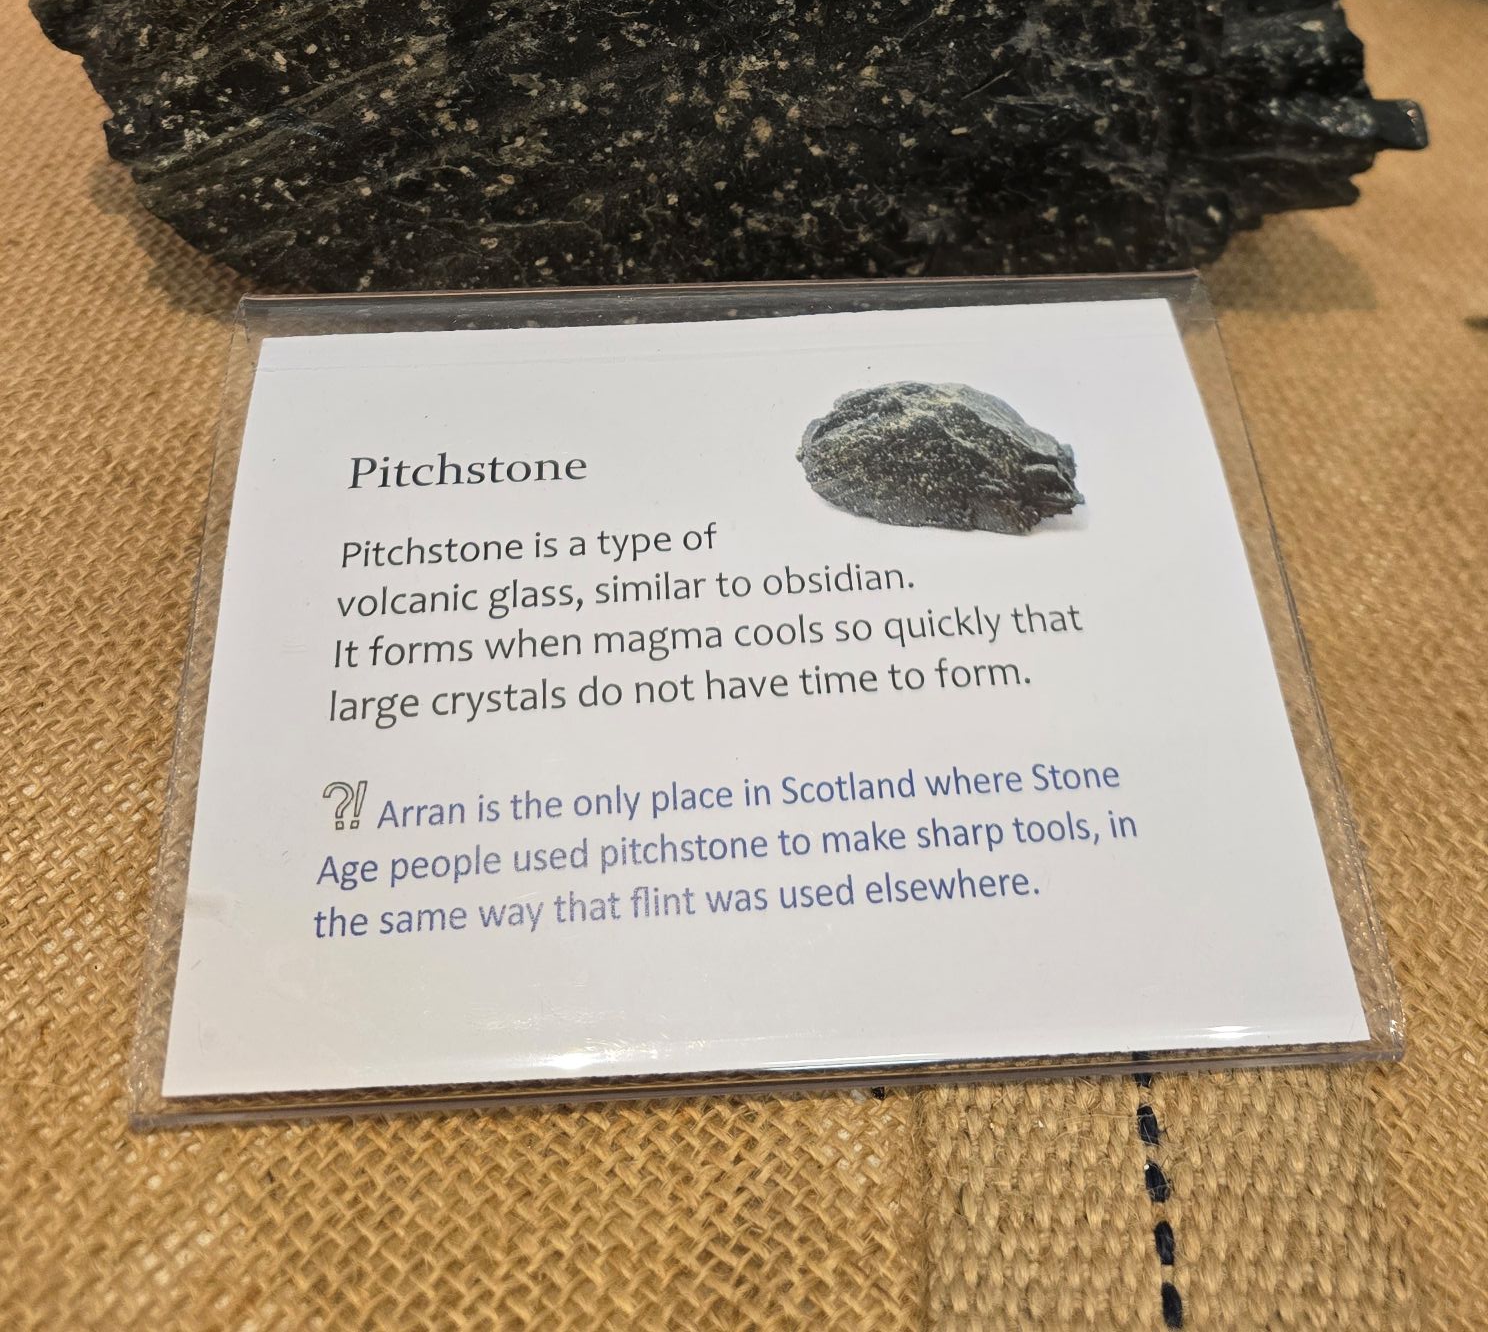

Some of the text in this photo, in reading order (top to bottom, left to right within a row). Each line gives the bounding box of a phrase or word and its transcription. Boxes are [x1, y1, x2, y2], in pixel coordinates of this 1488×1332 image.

[347, 451, 587, 490] Pitchstone
[341, 521, 718, 569] Pitchstone is a type of
[336, 562, 915, 620] volcanic glass, similar to obsidian.
[334, 603, 1084, 669] It forms when magma cools so quickly that
[329, 656, 1031, 730] large crystals do not have time to form.
[376, 800, 466, 830] Arran
[478, 793, 501, 823] is
[509, 789, 563, 821] the
[573, 784, 641, 821] only
[651, 780, 733, 820] place
[743, 778, 771, 807] in
[781, 768, 916, 805] Scotland
[924, 765, 1023, 797] where
[1031, 763, 1121, 792] Stone
[315, 809, 1138, 892] Age people used pitchstone to make sharp tools, in
[313, 867, 1040, 939] the same way that flint was used elsewhere.
